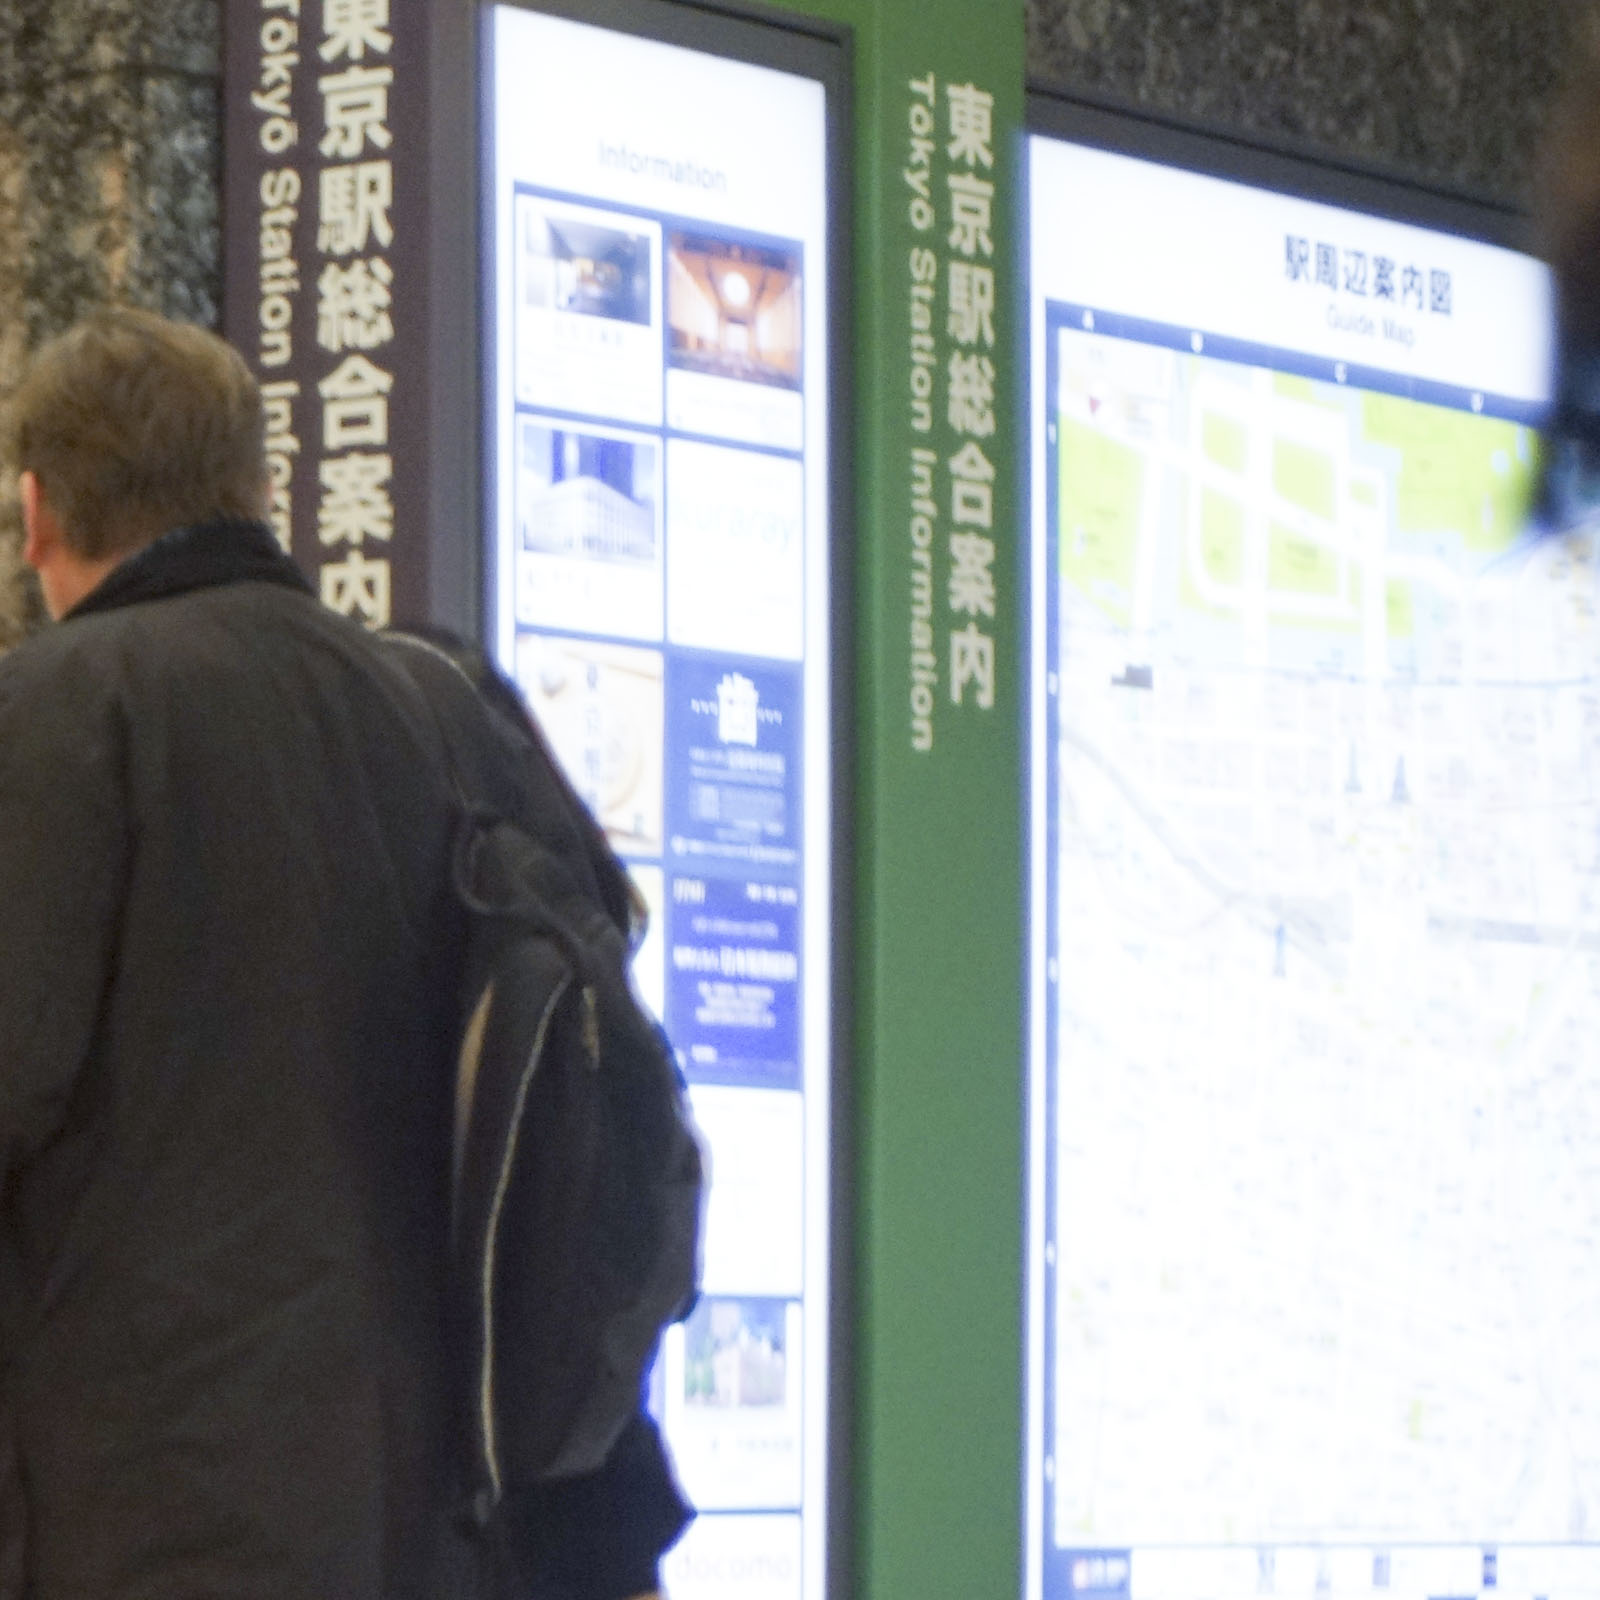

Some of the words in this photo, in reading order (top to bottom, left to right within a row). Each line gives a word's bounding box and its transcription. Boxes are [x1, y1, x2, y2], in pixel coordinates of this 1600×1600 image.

[599, 138, 729, 193] Information
[259, 167, 301, 367] Station
[908, 246, 937, 433] Station
[1284, 233, 1455, 316] 駅周辺案内図
[946, 82, 996, 711] 東京駅総合案内
[908, 449, 938, 752] Information
